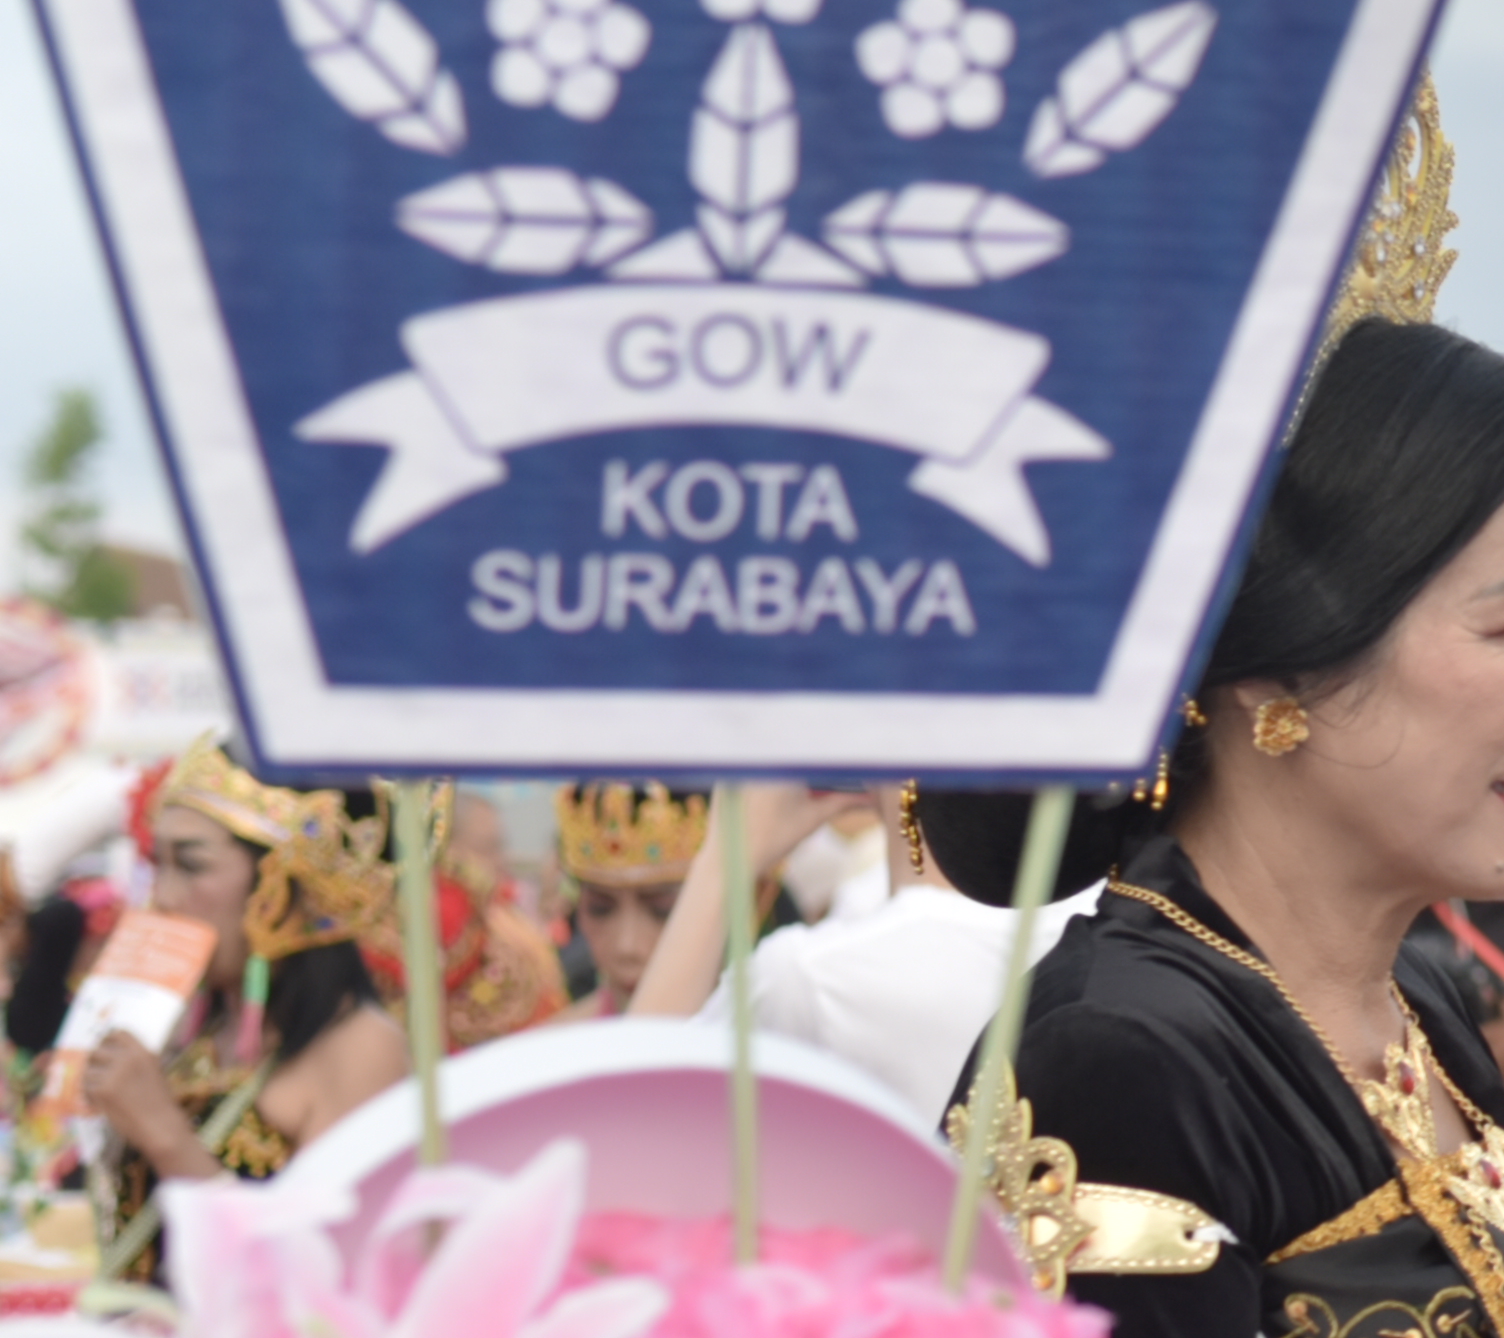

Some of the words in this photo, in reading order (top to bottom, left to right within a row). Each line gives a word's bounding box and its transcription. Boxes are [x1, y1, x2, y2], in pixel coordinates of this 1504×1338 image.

[607, 311, 870, 395] GOW
[602, 460, 858, 543] KOTA
[467, 549, 976, 637] SURABAYA
